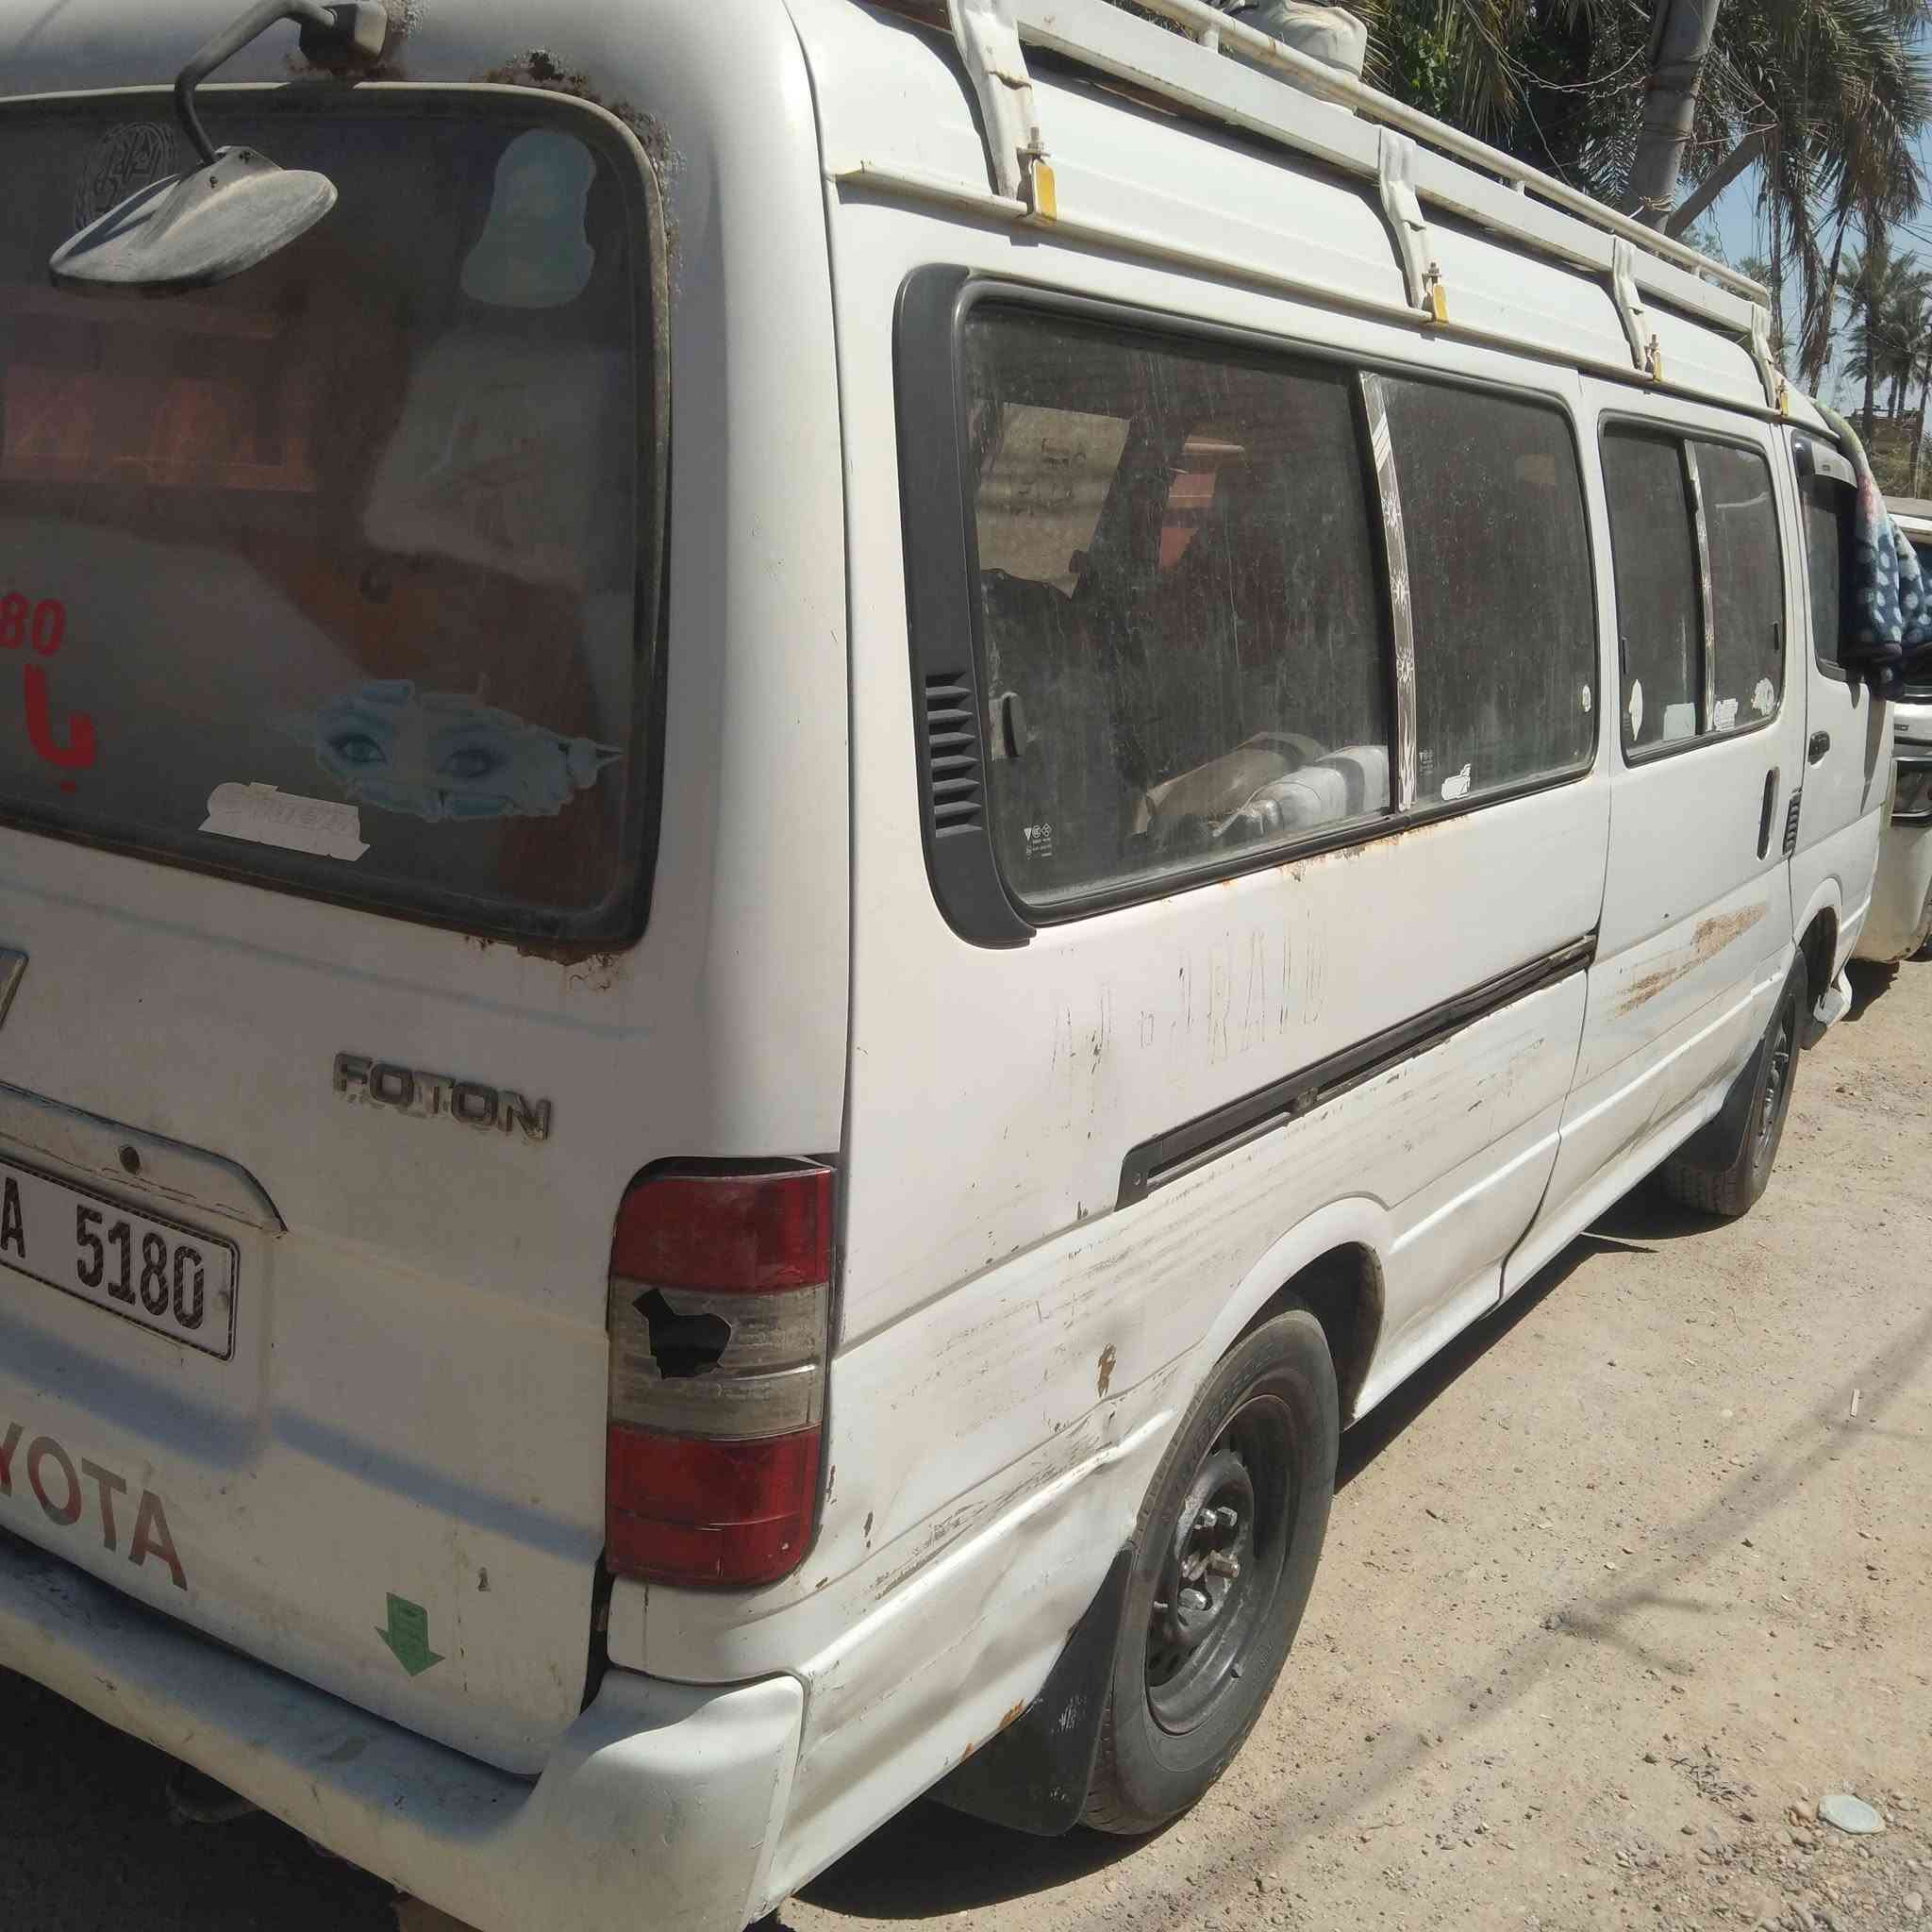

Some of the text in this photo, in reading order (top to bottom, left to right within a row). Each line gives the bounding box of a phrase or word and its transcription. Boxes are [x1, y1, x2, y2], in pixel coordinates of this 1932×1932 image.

[0, 591, 65, 657] 80
[333, 1052, 552, 1141] FOTON
[0, 1176, 205, 1330] A 5180
